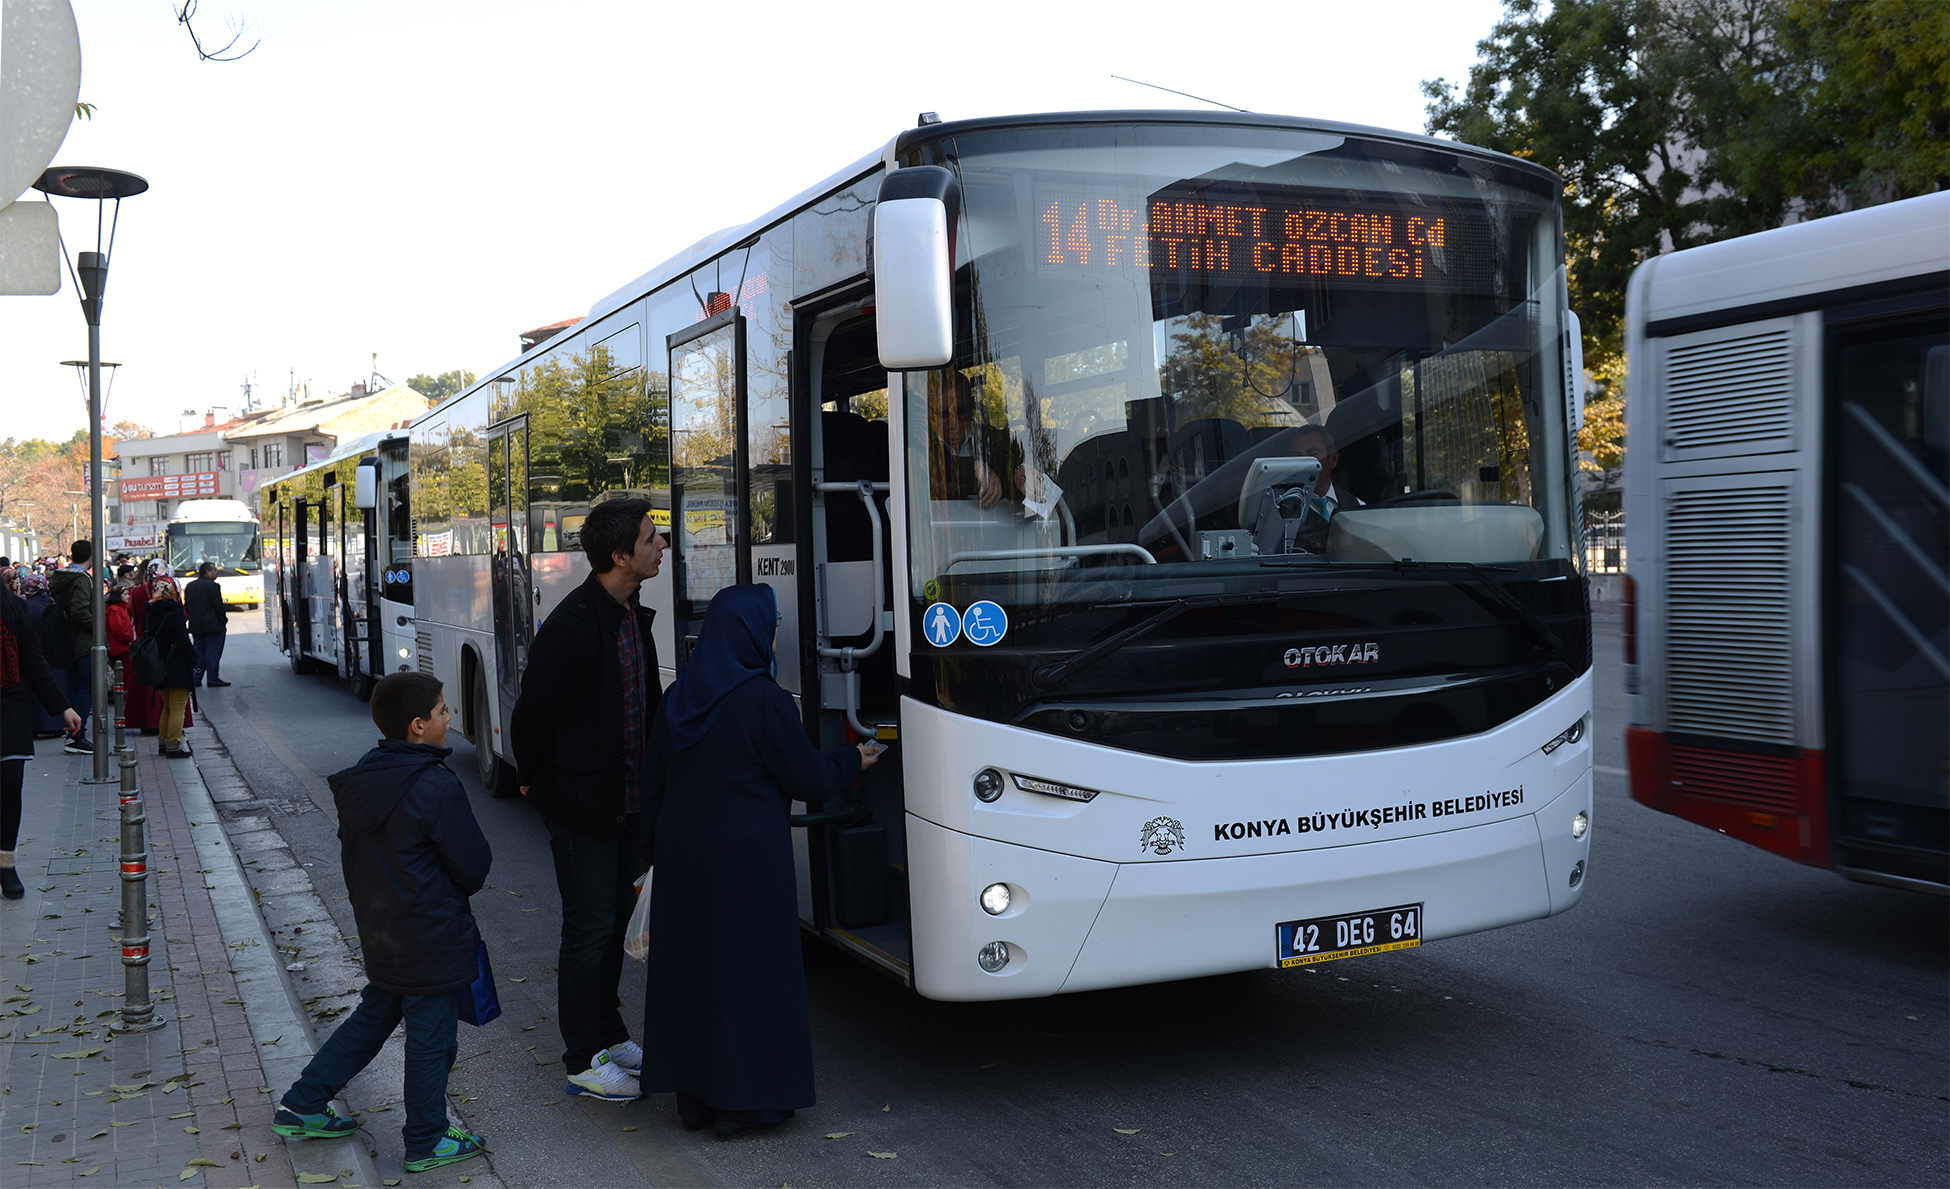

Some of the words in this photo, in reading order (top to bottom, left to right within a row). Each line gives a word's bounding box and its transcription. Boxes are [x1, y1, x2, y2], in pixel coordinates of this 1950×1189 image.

[1042, 201, 1092, 264] 14
[1152, 202, 1267, 237] AHMET
[1253, 242, 1423, 278] CADDESİ
[757, 556, 780, 576] KENT
[1284, 642, 1380, 669] OTOKAR
[1214, 818, 1291, 841] KONYA
[1298, 801, 1427, 830] BÜYÜKŞEHİR
[1432, 785, 1524, 817] BELEDİYESİ
[1281, 943, 1291, 952] TR
[1293, 924, 1320, 953] 42
[1336, 916, 1375, 948] DEG
[1390, 911, 1416, 940] 64
